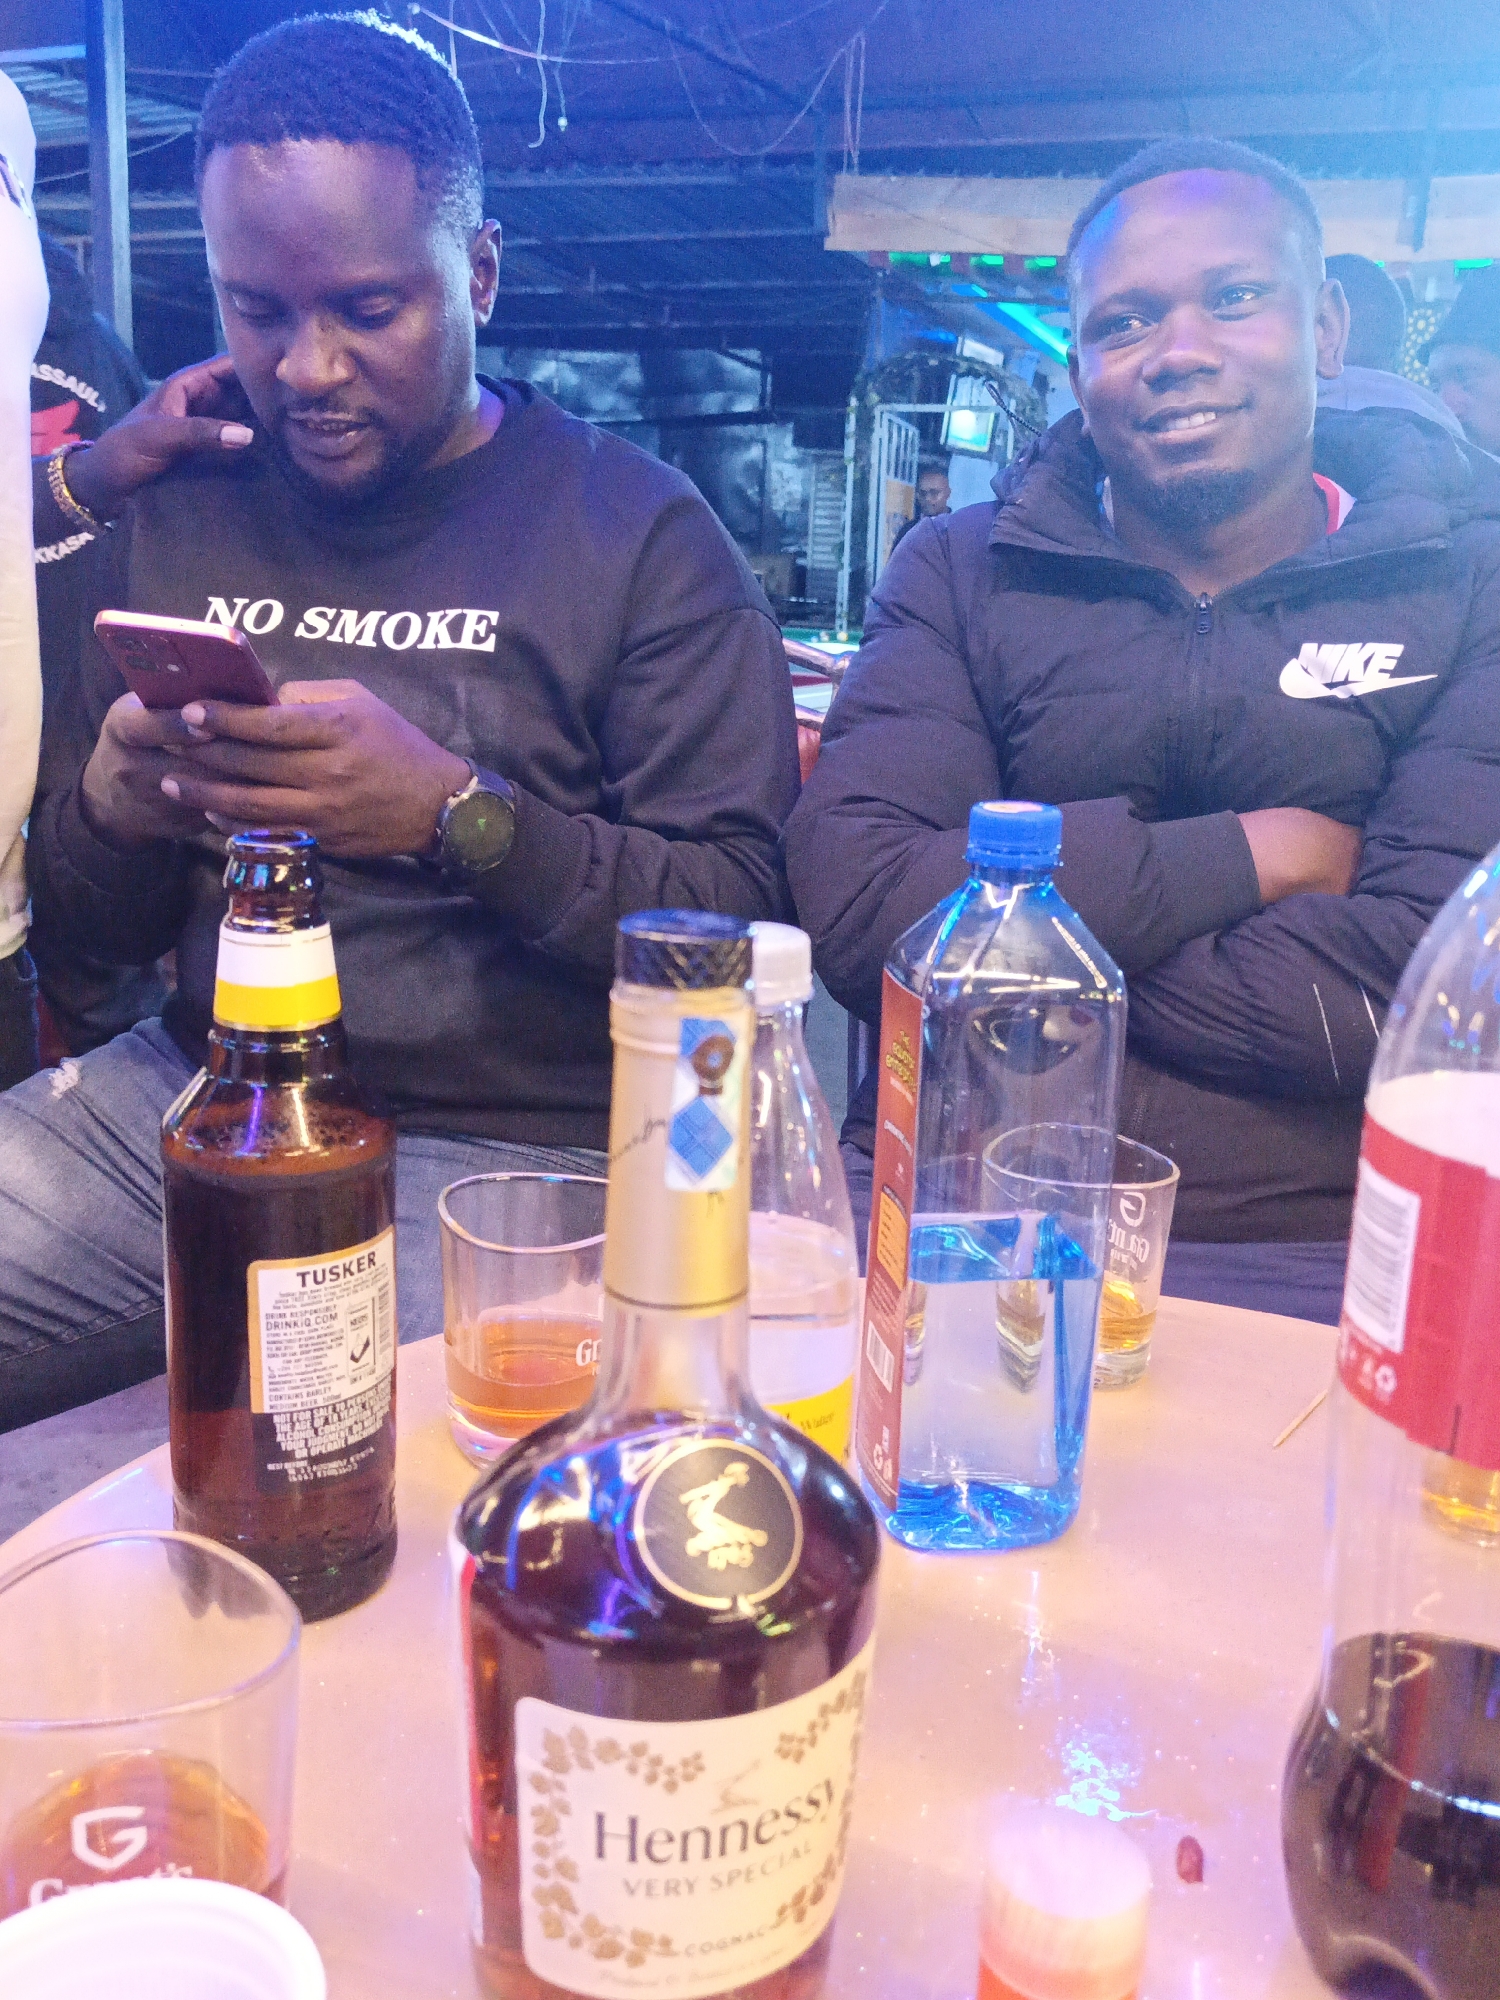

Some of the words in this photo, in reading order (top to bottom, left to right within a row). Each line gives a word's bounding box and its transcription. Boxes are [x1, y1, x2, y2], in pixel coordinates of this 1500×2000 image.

[204, 596, 285, 635] NO
[294, 606, 501, 653] SMOKE
[1298, 642, 1404, 683] NIKE
[296, 1250, 377, 1288] TUSKER
[622, 1874, 700, 1900] VERY
[709, 1838, 814, 1893] SPECIAL
